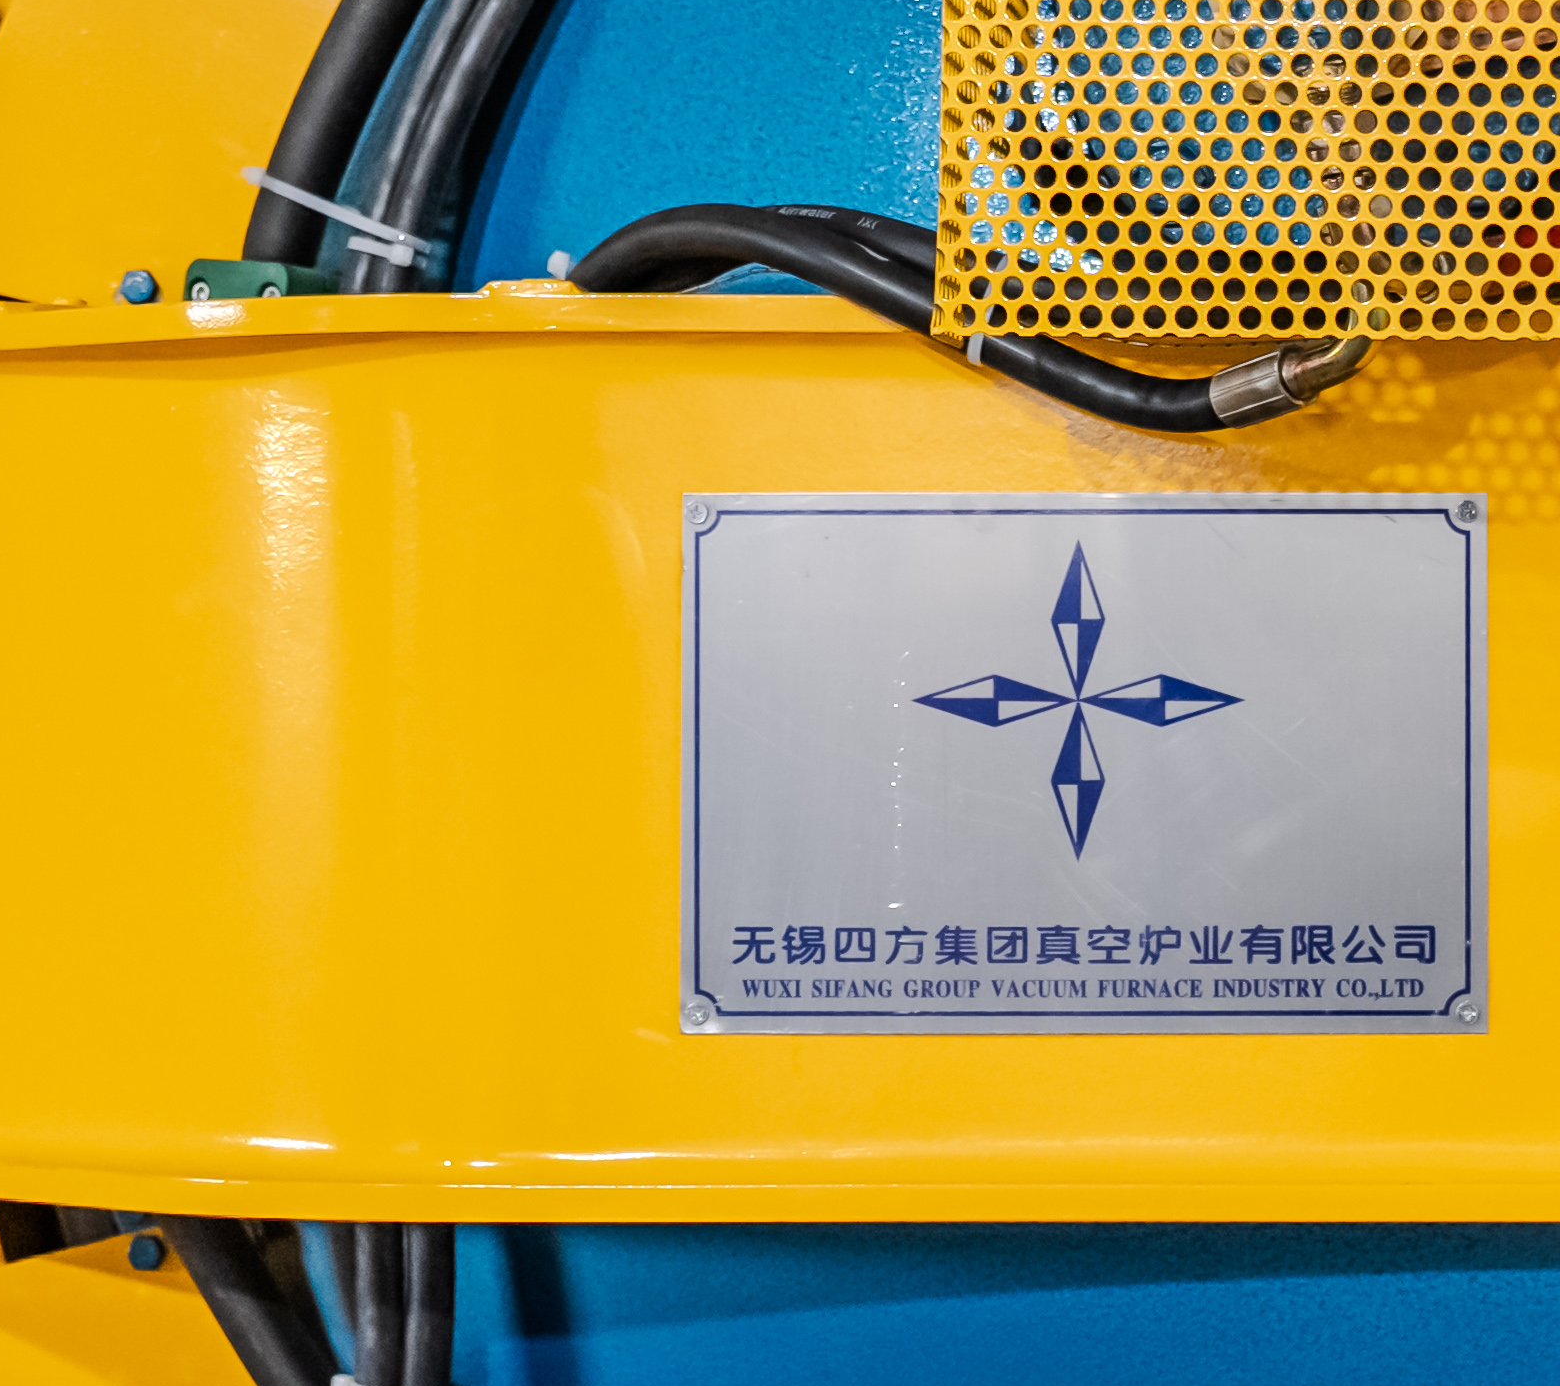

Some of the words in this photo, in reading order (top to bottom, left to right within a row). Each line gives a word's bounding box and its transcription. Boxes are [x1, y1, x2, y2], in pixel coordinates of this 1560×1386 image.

[732, 925, 1437, 965] 无锡四方集团真空炉业有限公司
[742, 979, 802, 999] WUXI
[810, 979, 894, 999] SIFANG
[903, 979, 981, 999] GROUP
[991, 979, 1088, 999] VACUUM
[1097, 979, 1203, 999] FURNACE
[1212, 979, 1326, 999] INDUSTRY
[1335, 979, 1425, 1001] CO.,LTD
